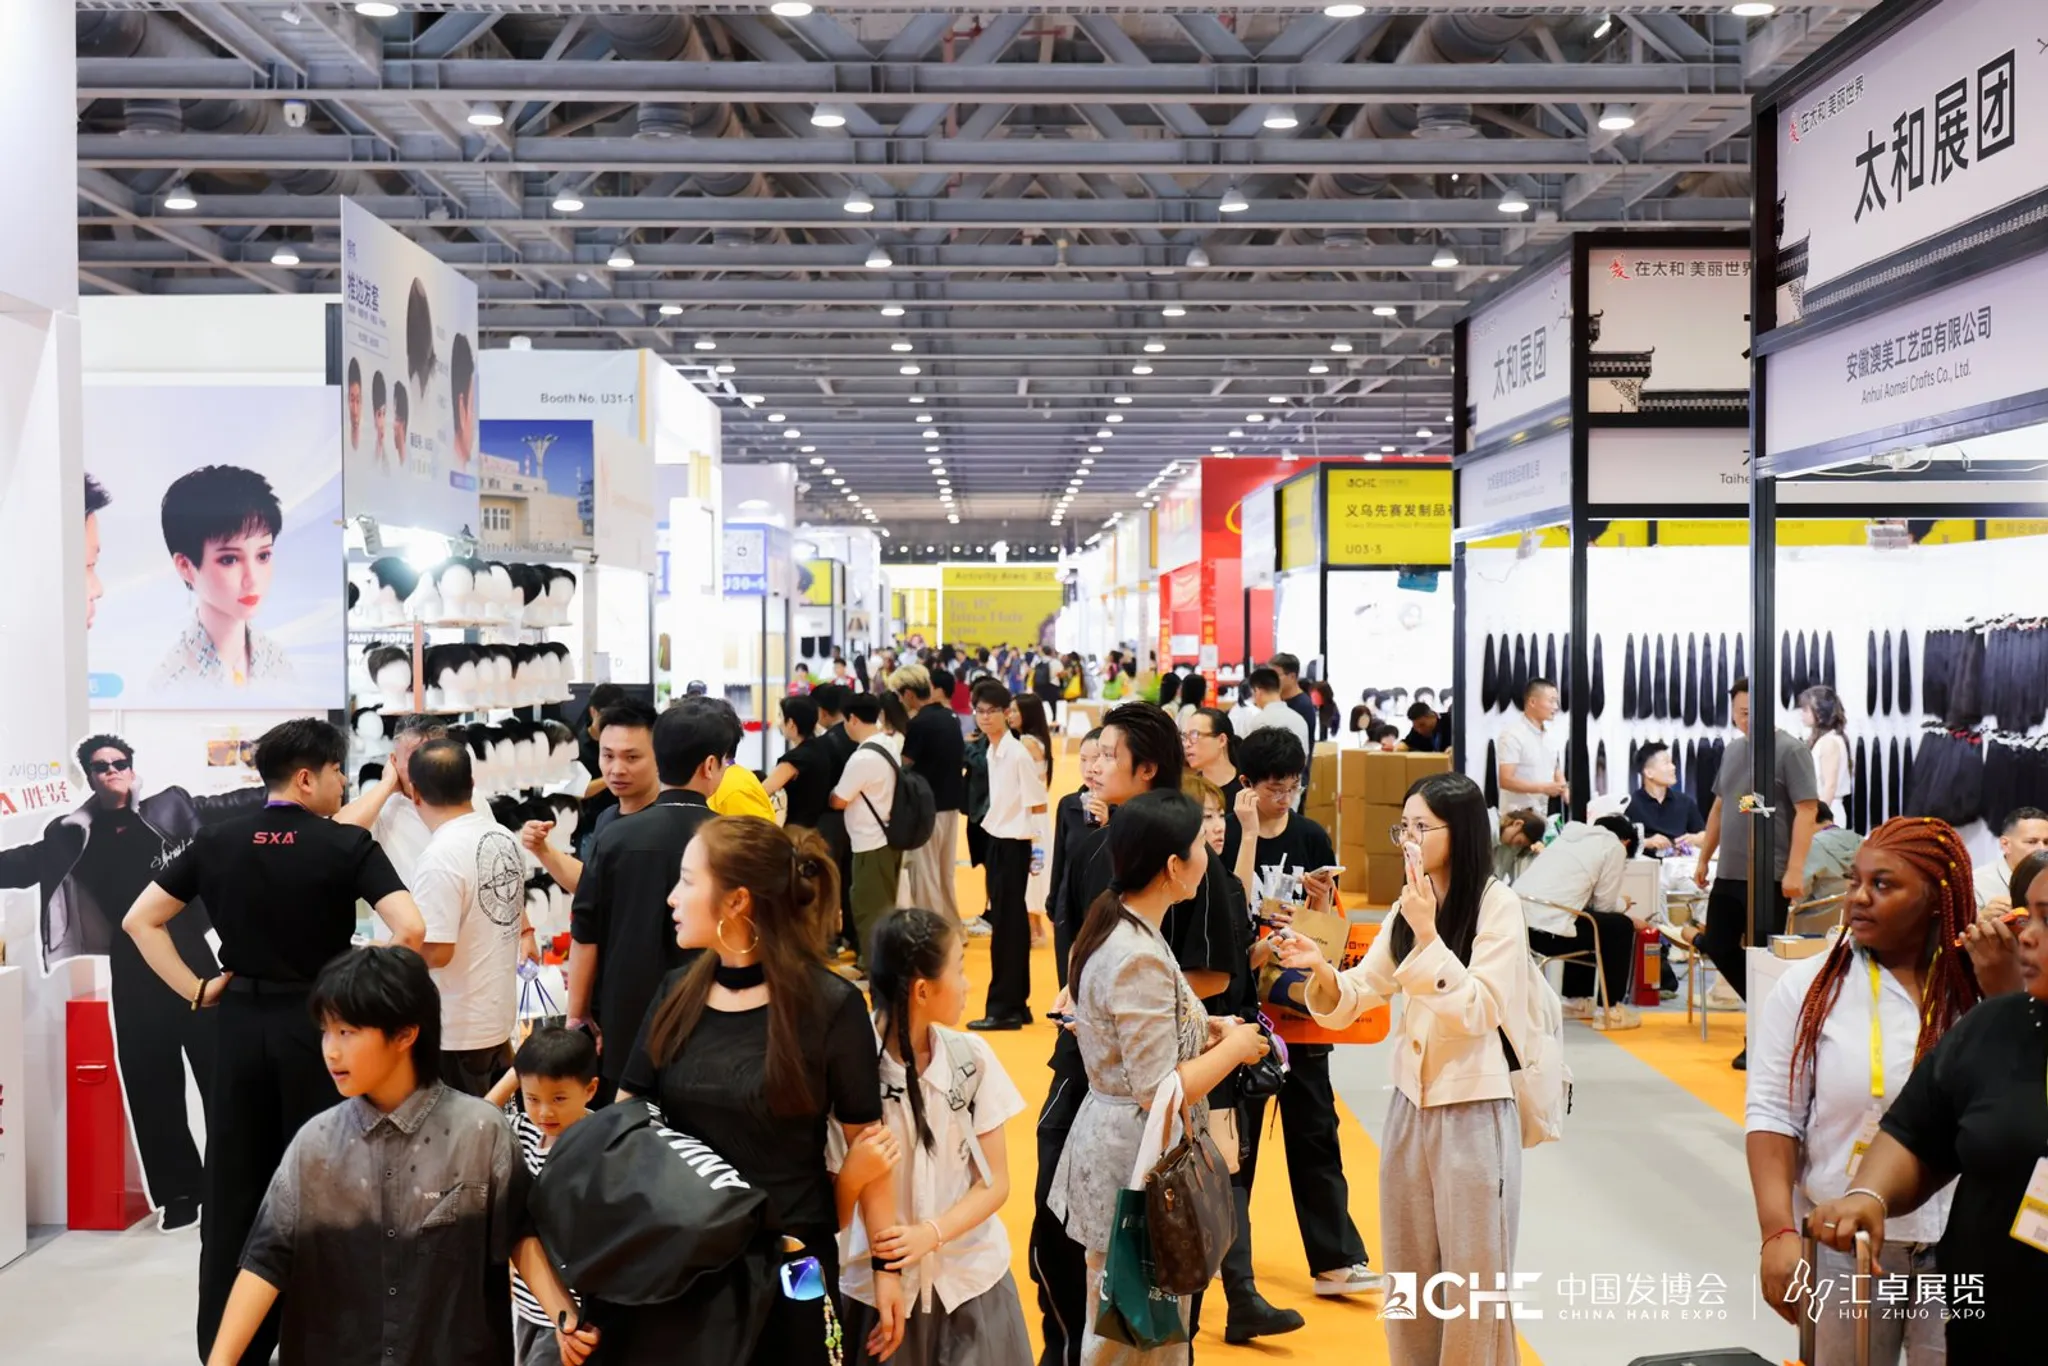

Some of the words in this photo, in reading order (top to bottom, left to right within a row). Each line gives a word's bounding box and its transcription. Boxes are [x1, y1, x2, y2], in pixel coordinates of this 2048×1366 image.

[1854, 49, 2015, 224] 太和展团
[1635, 261, 1685, 277] 在太和
[1493, 326, 1546, 400] 太和展团
[1846, 305, 1992, 383] 安徽澳美工艺品有限公司
[540, 393, 575, 404] Booth
[578, 393, 597, 404] No.
[601, 393, 634, 404] U31-1
[1861, 384, 1883, 405] Anhui
[1884, 376, 1909, 399] Aomei
[1909, 370, 1935, 392] Crafts
[1936, 366, 1953, 384] Co.,
[1954, 358, 1972, 379] Ltd.
[253, 831, 295, 844] SXA
